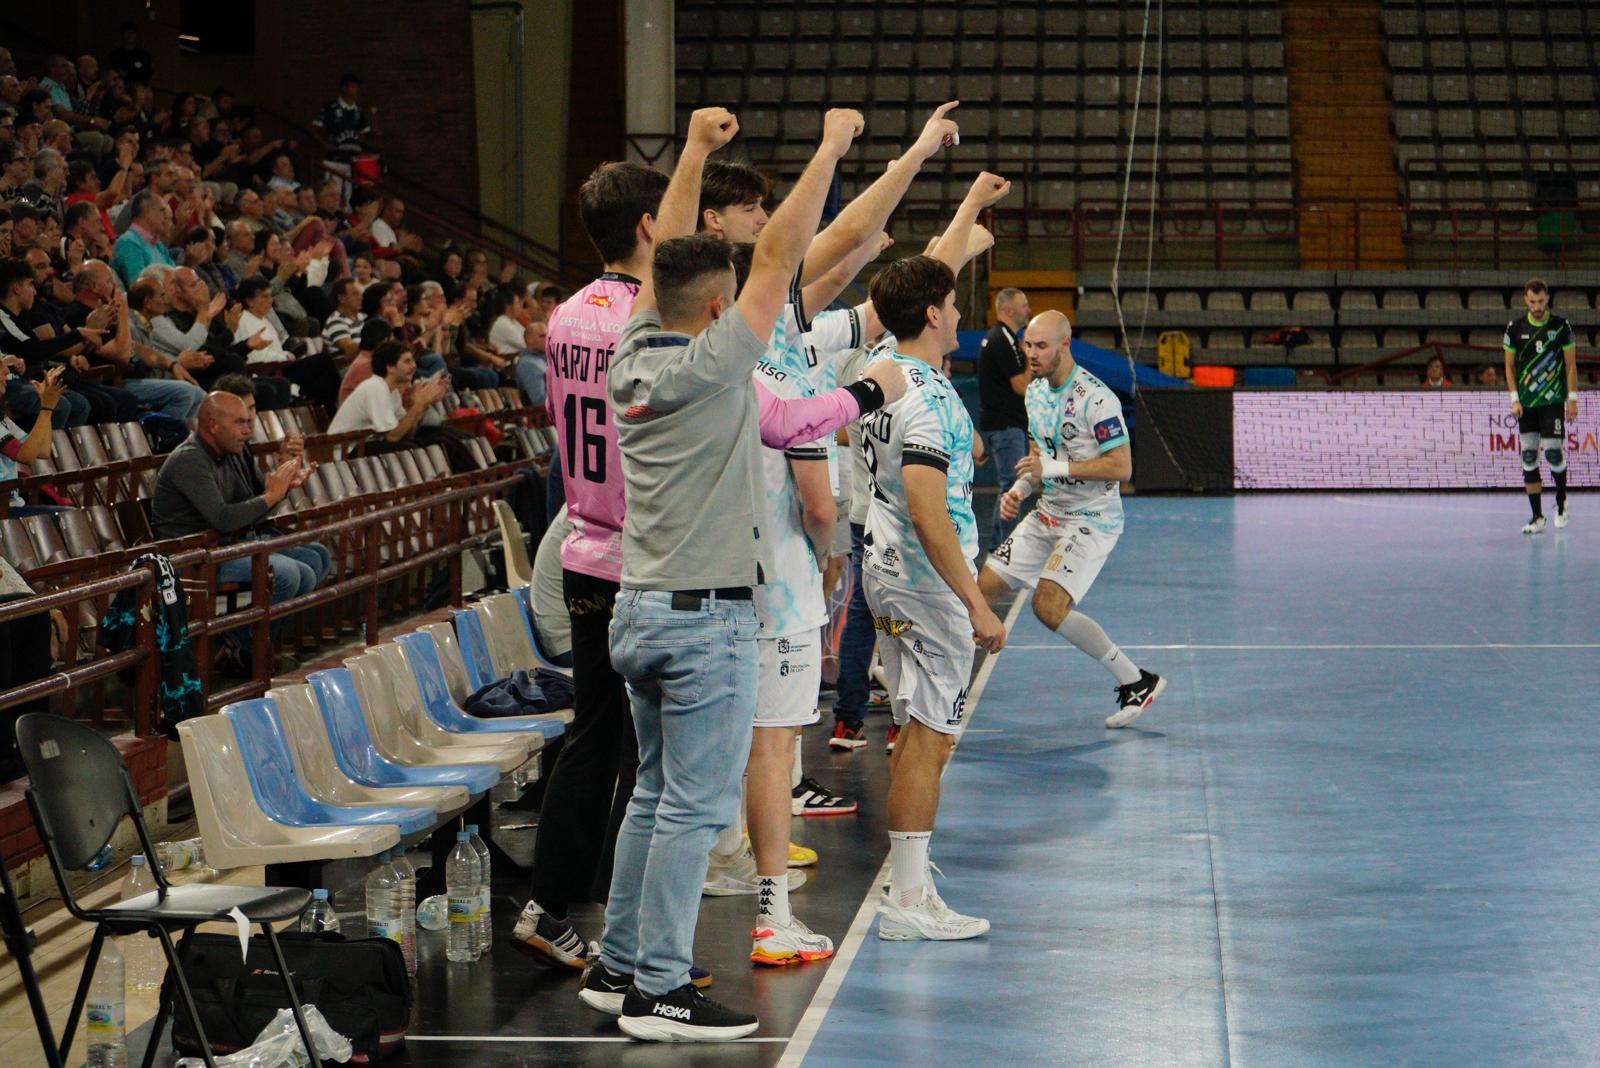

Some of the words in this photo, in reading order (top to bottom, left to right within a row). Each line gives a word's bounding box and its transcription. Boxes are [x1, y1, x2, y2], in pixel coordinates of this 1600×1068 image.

[1535, 340, 1544, 354] 8
[1554, 418, 1562, 430] 8
[563, 393, 607, 484] 16
[652, 1002, 691, 1021] HOKA
